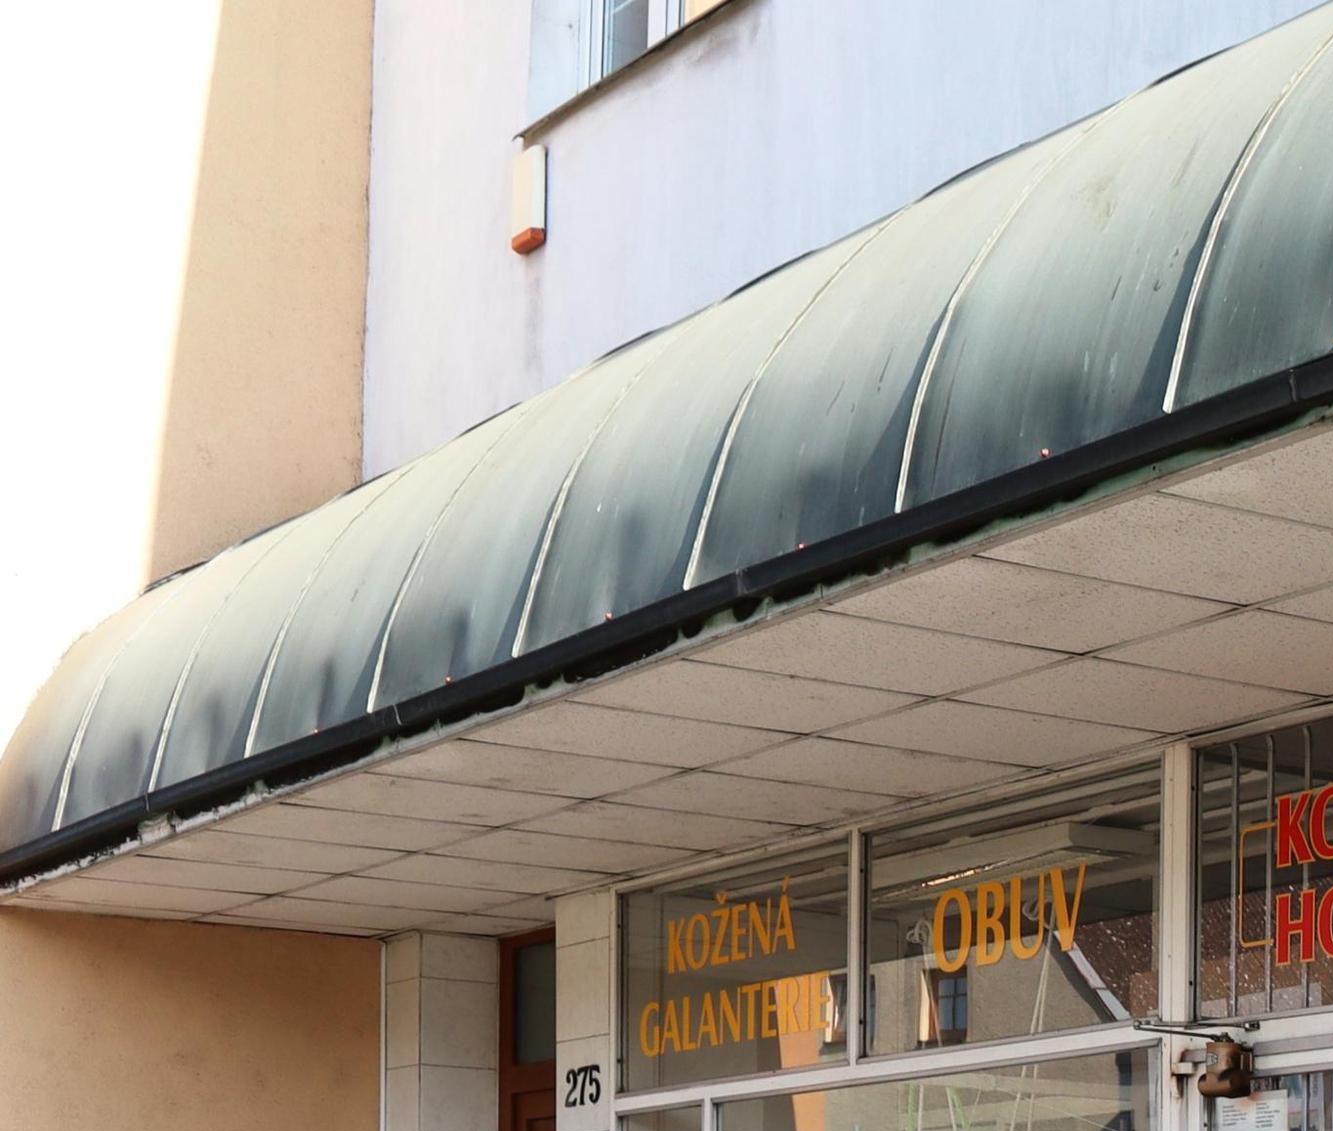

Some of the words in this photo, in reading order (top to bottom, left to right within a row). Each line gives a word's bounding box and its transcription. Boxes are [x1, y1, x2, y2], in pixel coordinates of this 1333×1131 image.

[667, 877, 796, 974] KOŽENÁ
[933, 863, 1089, 972] OBUV
[640, 969, 831, 1058] GALANTERIE
[566, 1064, 600, 1108] 275
